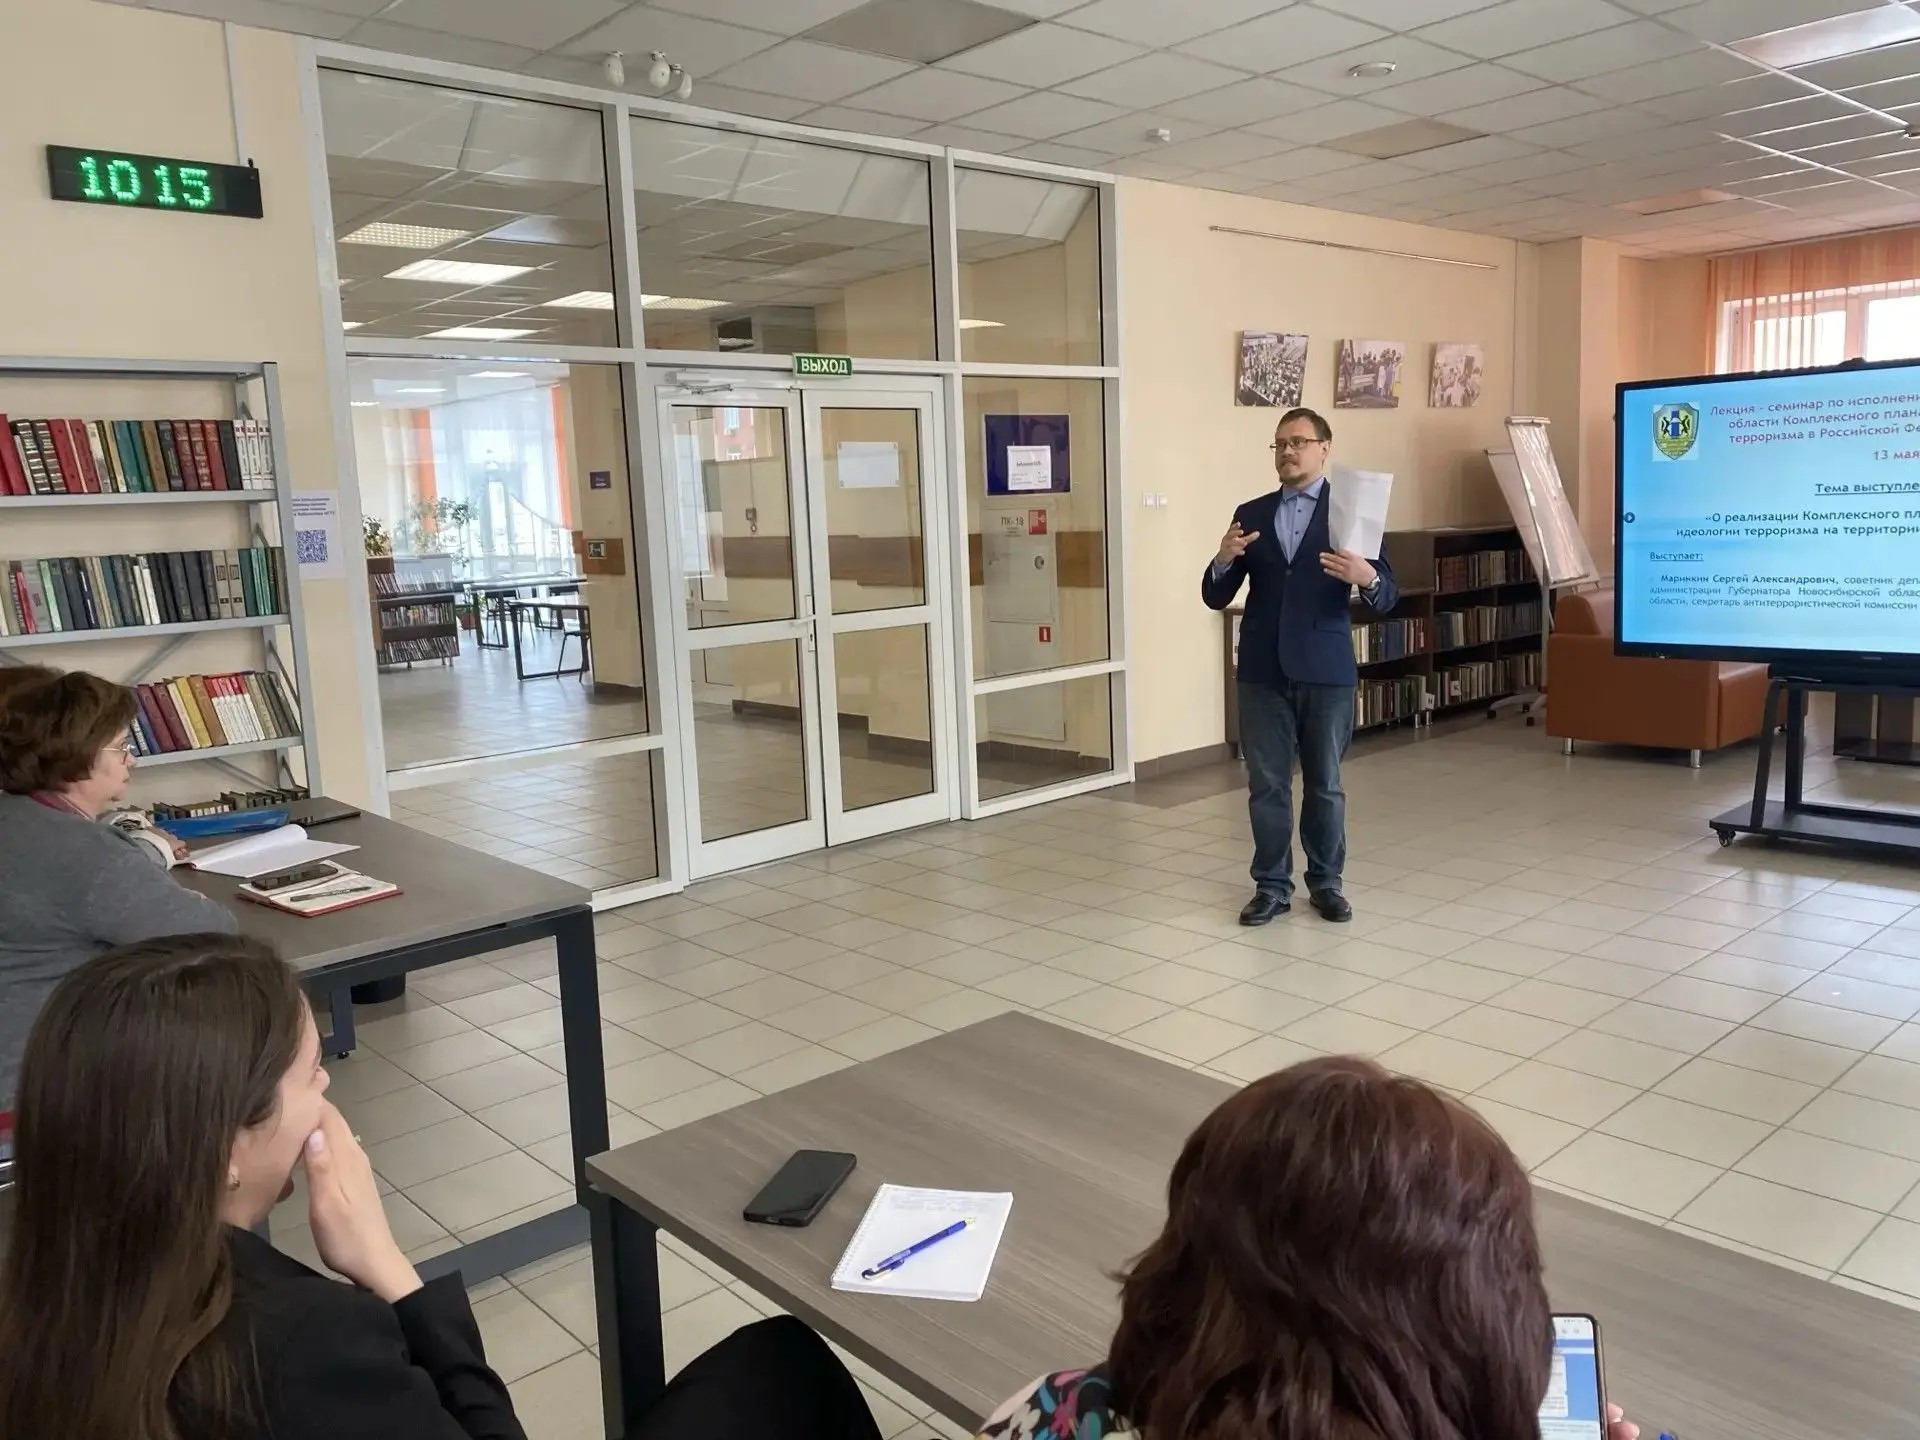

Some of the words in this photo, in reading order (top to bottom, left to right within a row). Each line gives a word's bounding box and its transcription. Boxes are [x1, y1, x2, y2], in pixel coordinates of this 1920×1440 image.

[80, 156, 141, 200] 10
[154, 165, 211, 207] 15
[800, 358, 848, 374] ВЫХОД
[1710, 405, 1755, 417] Лекция
[1768, 400, 1824, 412] семинар
[1828, 399, 1844, 408] по
[1729, 417, 1779, 429] области
[1783, 411, 1880, 425] Комплексного
[1729, 431, 1804, 444] терроризма
[1808, 430, 1815, 439] в
[1820, 423, 1900, 438] Российской
[1873, 449, 1888, 460] 13
[1893, 450, 1920, 460] мая
[1815, 483, 1849, 493] Тема
[1853, 482, 1920, 494] выступле
[1725, 513, 1798, 524] реализации
[1803, 510, 1900, 521] Комплексного
[1676, 528, 1740, 538] идеологии
[1744, 526, 1819, 538] терроризма
[1823, 526, 1838, 535] на
[1649, 551, 1704, 561] Выступает:
[1712, 574, 1749, 584] Сергей
[1752, 574, 1839, 585] Александрович,
[1843, 577, 1893, 585] советник
[1898, 577, 1920, 586] деп
[1649, 587, 1721, 595] администрации
[1728, 586, 1791, 597] Губернатора
[1798, 587, 1880, 598] Новосибирской
[1649, 597, 1689, 606] области,
[1691, 598, 1741, 608] секретарь
[1743, 599, 1861, 609] антитеррористической
[1864, 601, 1917, 610] комиссии
